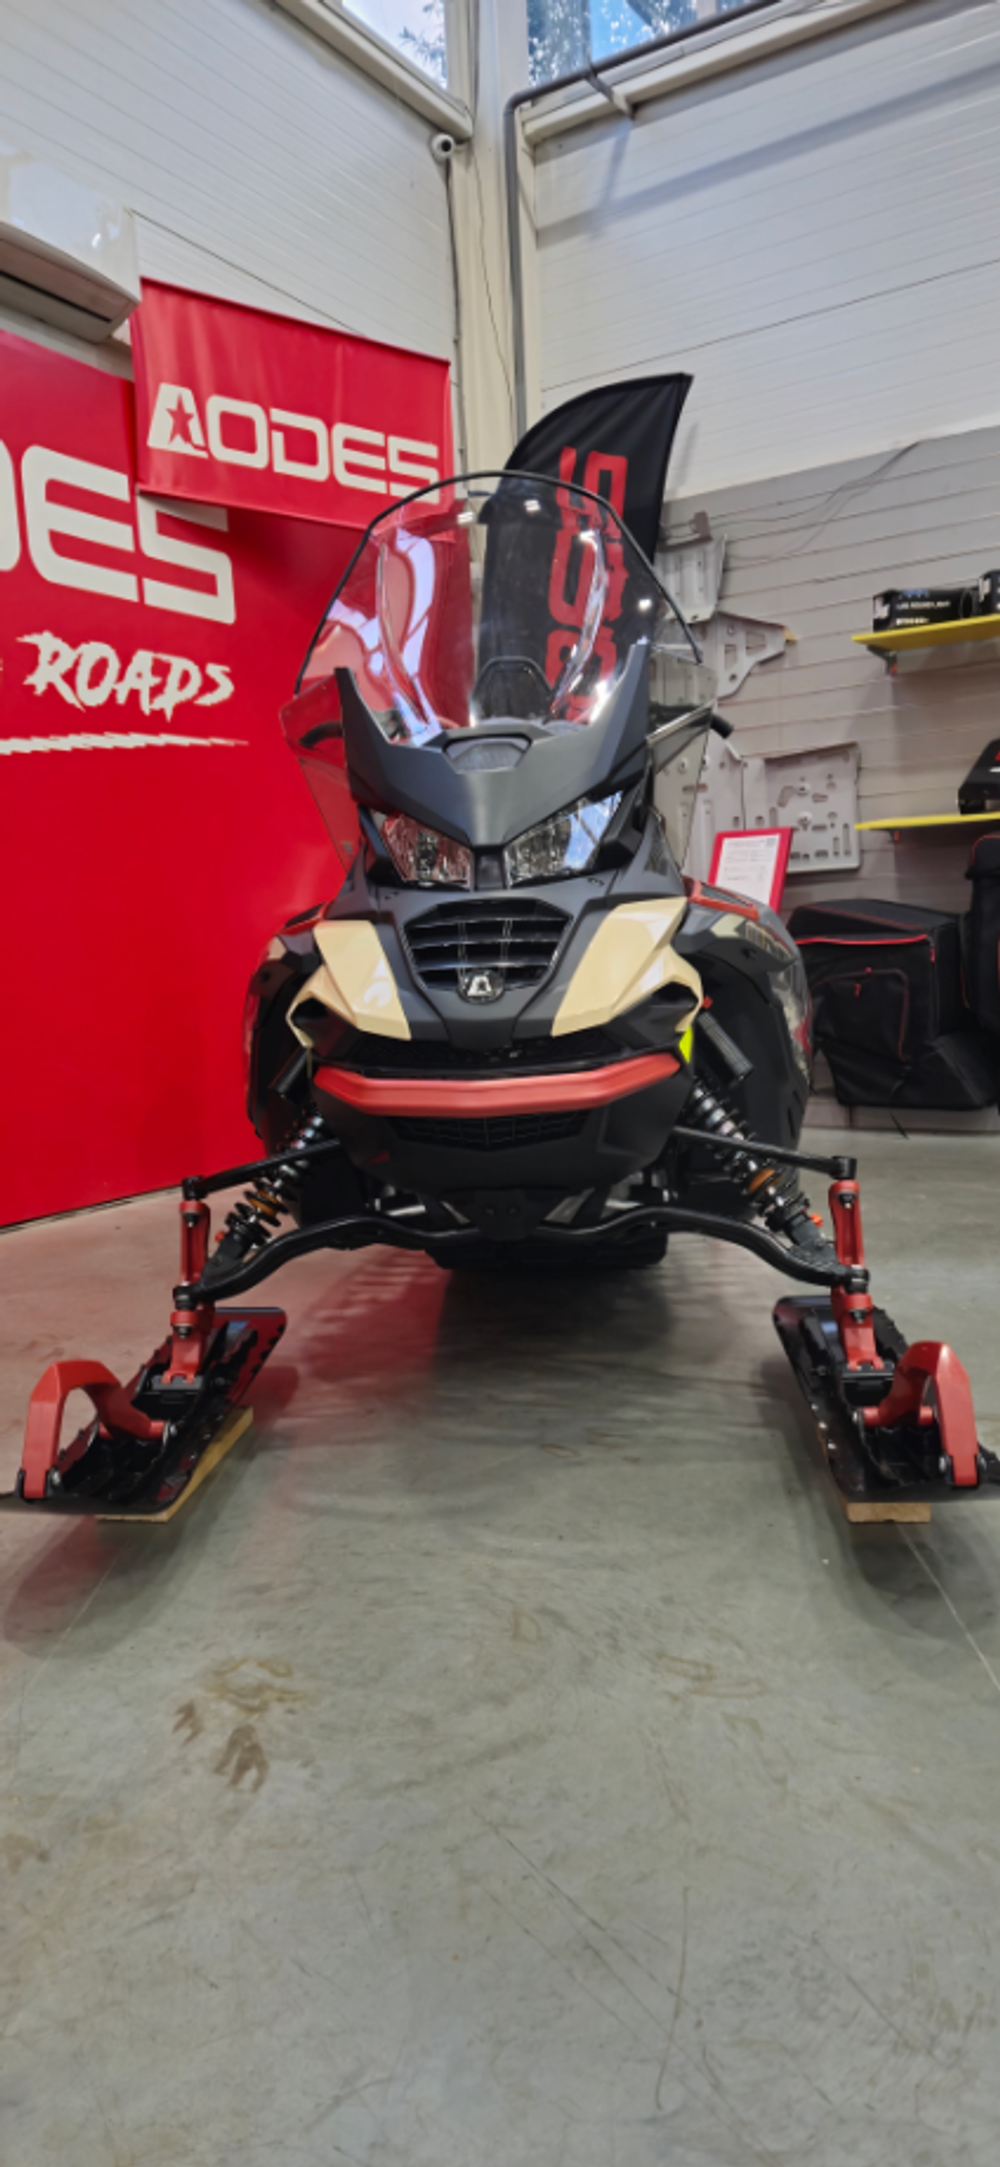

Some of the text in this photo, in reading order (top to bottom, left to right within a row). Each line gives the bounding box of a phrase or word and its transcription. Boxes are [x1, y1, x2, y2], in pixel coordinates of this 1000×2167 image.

[147, 382, 440, 504] AODES
[0, 438, 236, 625] ES
[16, 631, 235, 723] ROADS
